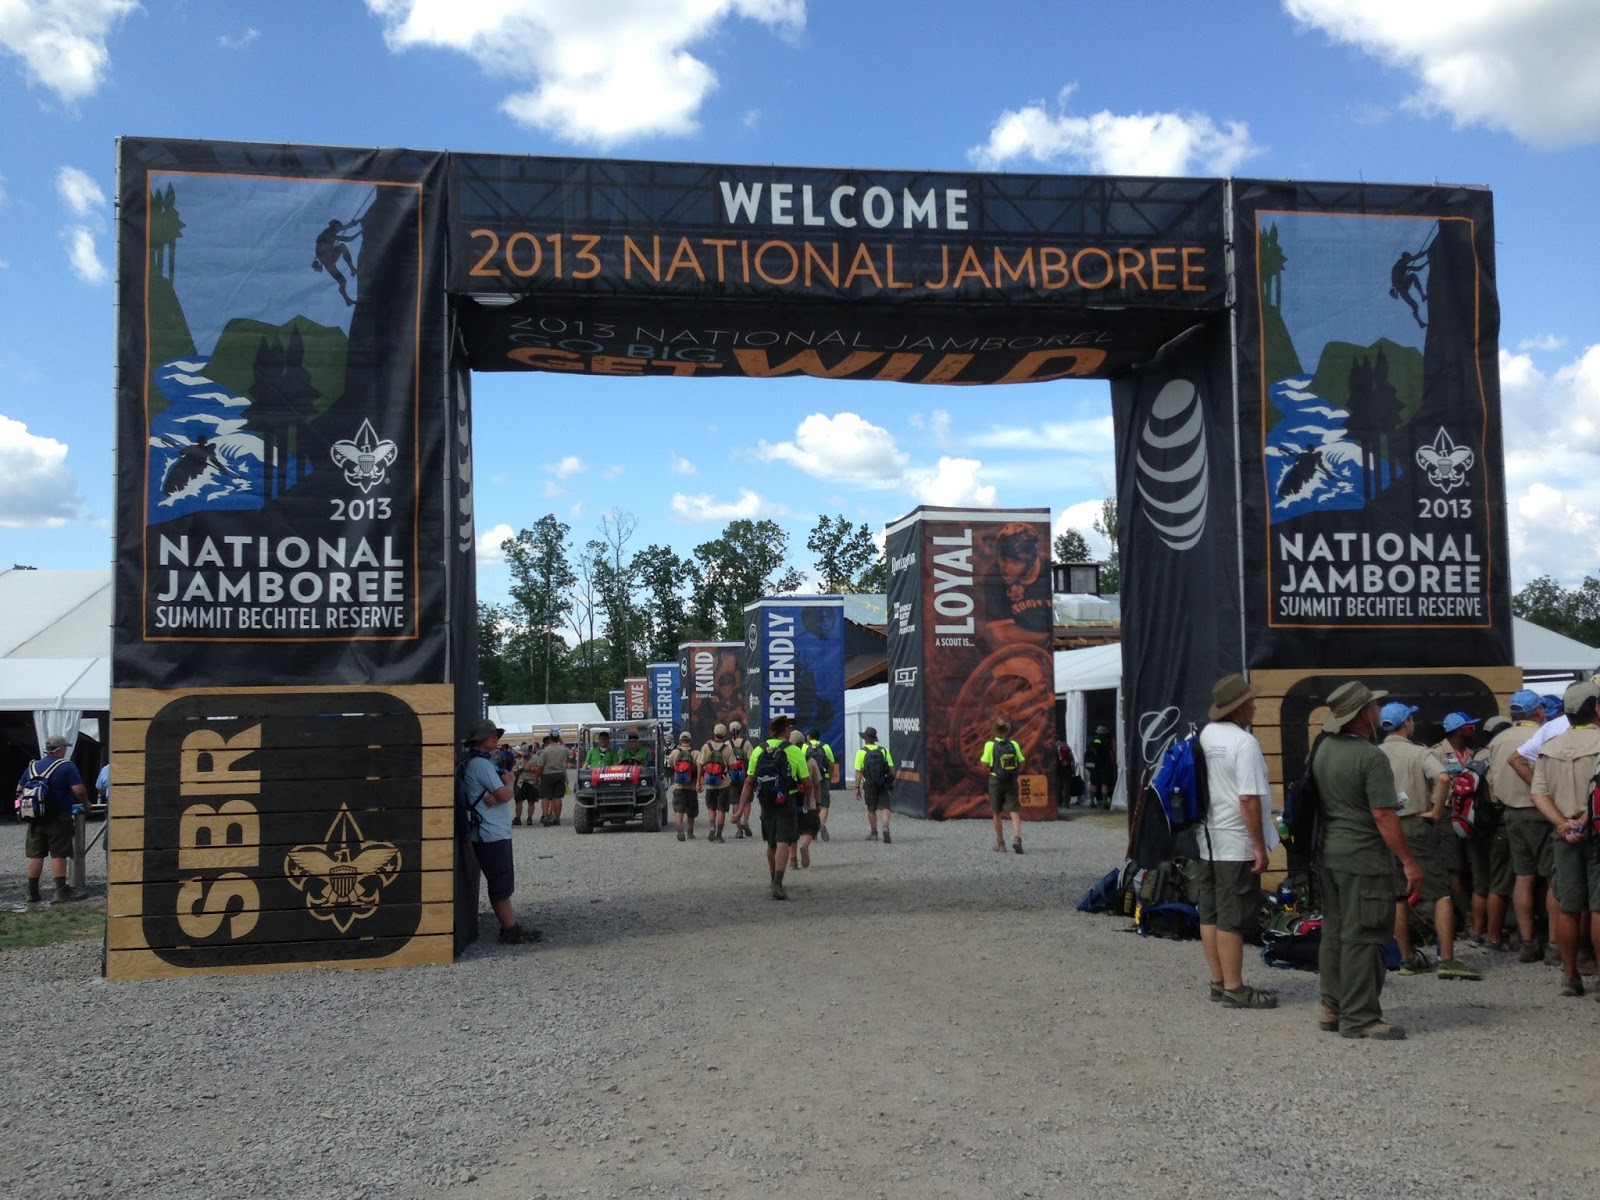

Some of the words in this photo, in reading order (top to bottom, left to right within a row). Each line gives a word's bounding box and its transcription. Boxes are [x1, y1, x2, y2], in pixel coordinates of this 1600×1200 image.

[720, 181, 969, 230] WELCOME
[469, 229, 602, 280] 2013
[623, 235, 912, 289] NATIONAL
[925, 246, 1207, 292] JAMBOREE
[508, 333, 604, 354] GO
[510, 316, 616, 339] 2013
[635, 326, 872, 349] NATIONAL
[506, 346, 723, 376] GET
[732, 348, 1107, 386] WILD
[329, 497, 393, 521] 2013
[1418, 498, 1472, 519] 2013
[158, 533, 404, 568] NATIONAL
[1279, 532, 1480, 562] NATIONAL
[157, 569, 404, 604] JAMBOREE
[933, 528, 975, 634] LOYAL
[1280, 564, 1480, 594] JAMBOREE
[155, 605, 234, 629] SUMMIT
[238, 606, 321, 629] BECHTEL
[326, 605, 405, 628] RESERVE
[1280, 596, 1341, 617] SUMMIT
[1346, 596, 1414, 617] BECHTEL
[1418, 596, 1482, 617] RESERVE
[935, 637, 941, 647] A
[941, 637, 962, 647] SCOUT
[694, 651, 715, 692] KIND
[768, 612, 796, 720] FRIENDLY
[631, 684, 645, 719] BRAVE
[1020, 778, 1031, 804] SBR
[176, 721, 263, 941] SBR
